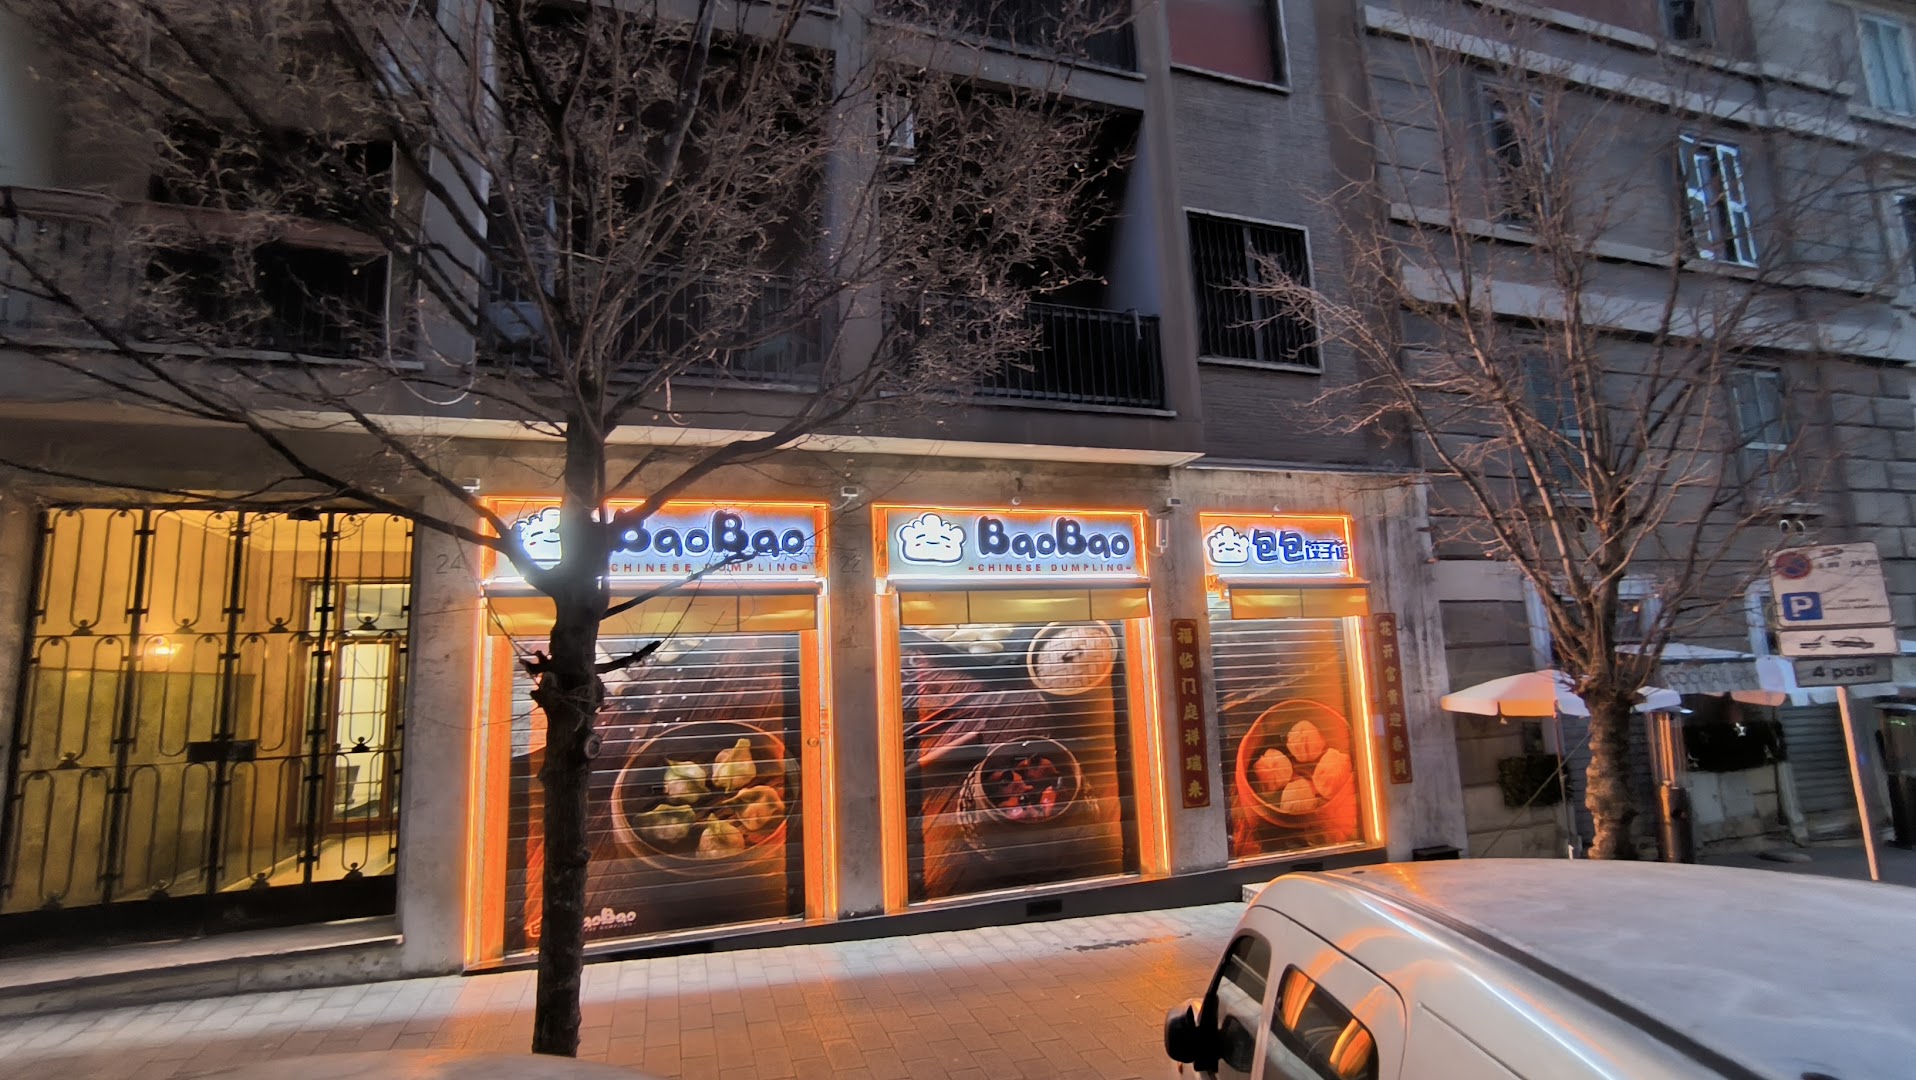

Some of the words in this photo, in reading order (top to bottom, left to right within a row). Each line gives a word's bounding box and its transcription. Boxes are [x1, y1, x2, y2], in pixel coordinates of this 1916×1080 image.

[978, 516, 1130, 559] BaoBao
[611, 563, 692, 573] CHINESE
[978, 563, 1042, 572] CHINESE
[1051, 563, 1123, 572] DUMPLING
[1789, 595, 1813, 617] P
[583, 907, 637, 928] aoBao
